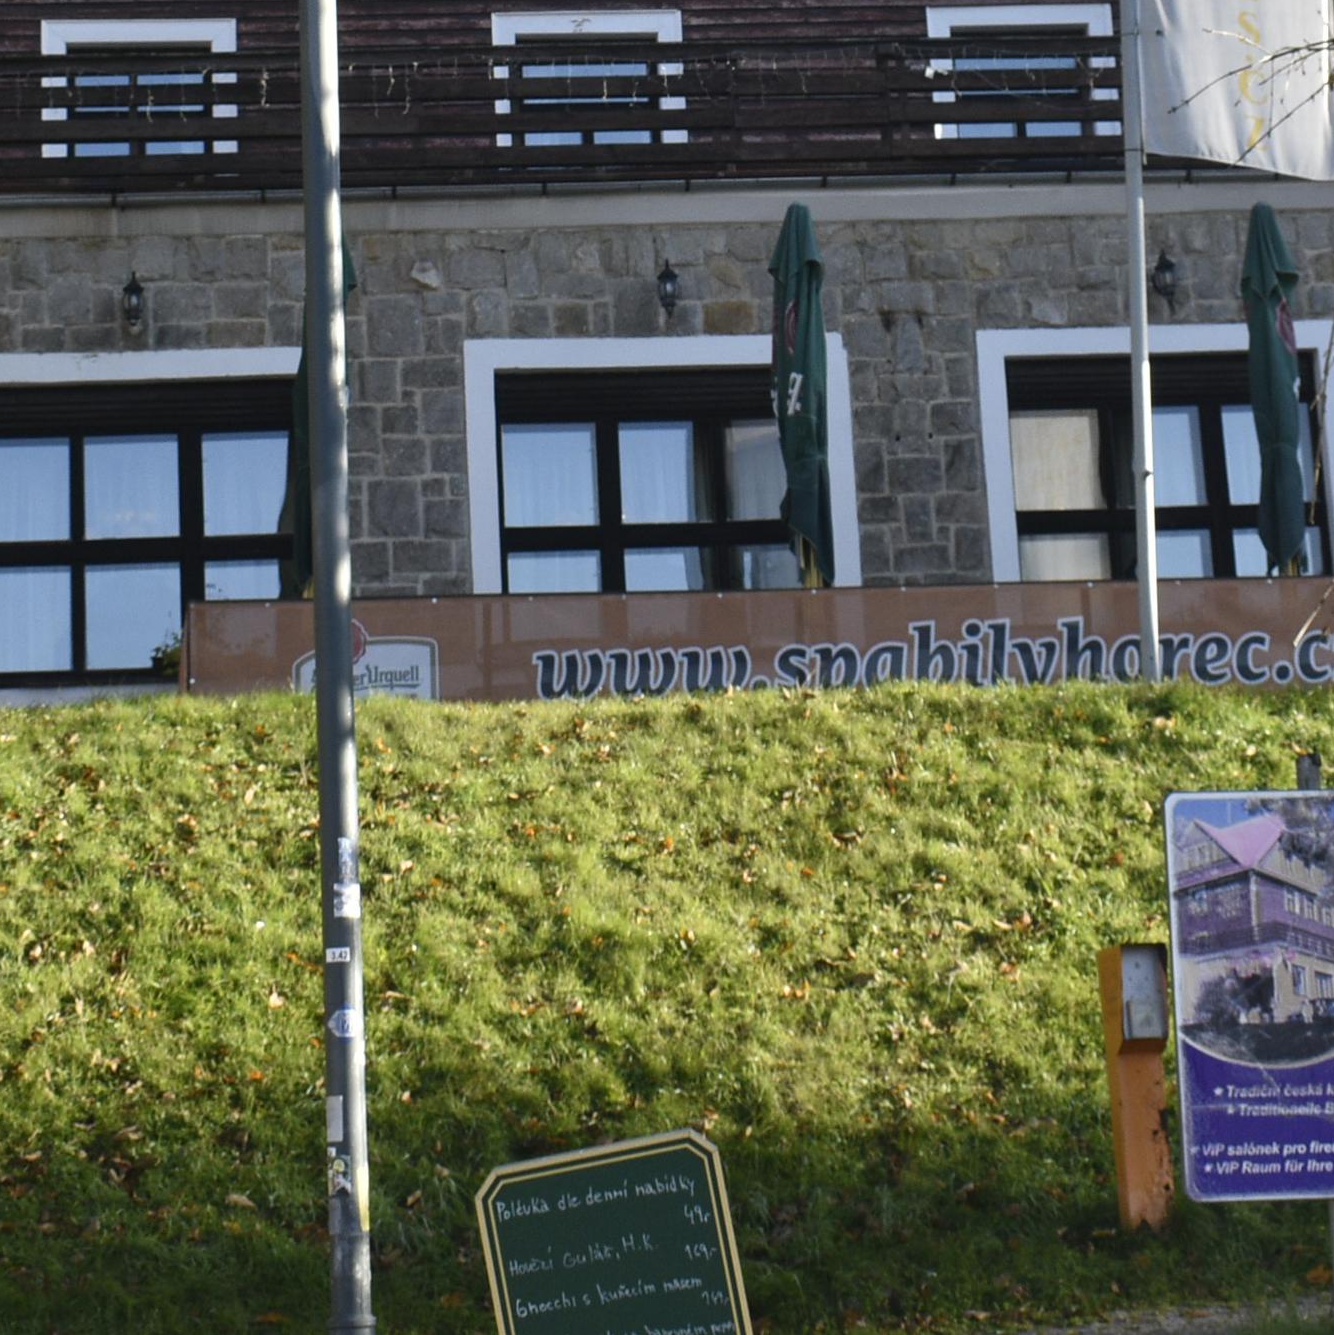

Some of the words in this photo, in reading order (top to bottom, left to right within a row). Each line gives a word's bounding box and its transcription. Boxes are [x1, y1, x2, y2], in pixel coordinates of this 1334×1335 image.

[1227, 1141, 1280, 1156] salónek
[1283, 1143, 1307, 1157] pro
[1242, 1160, 1281, 1174] Raum
[1284, 1159, 1305, 1172] für
[1307, 1158, 1334, 1172] Ihre
[558, 1193, 581, 1211] dle
